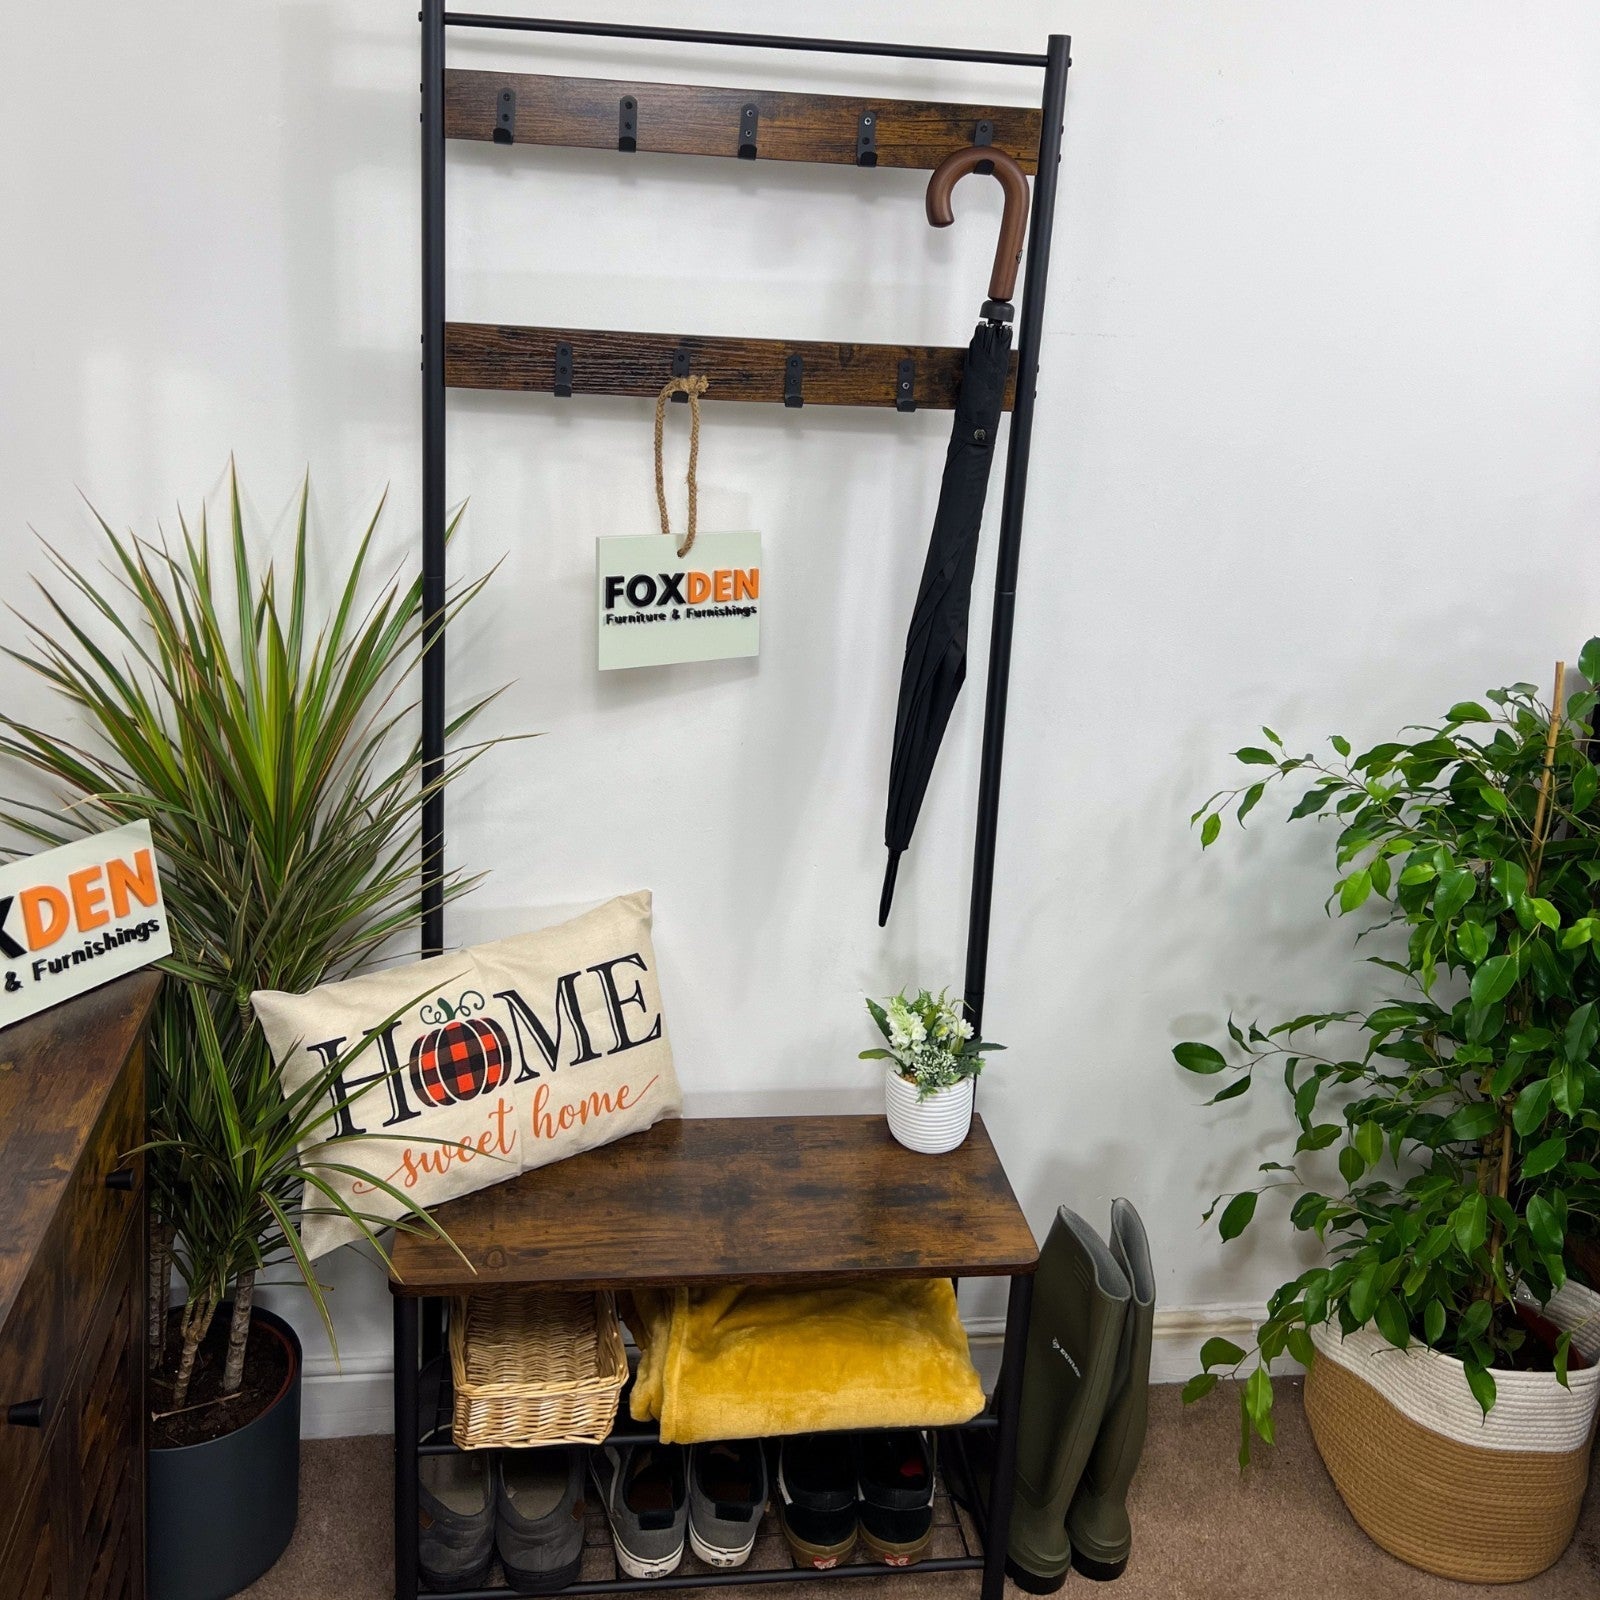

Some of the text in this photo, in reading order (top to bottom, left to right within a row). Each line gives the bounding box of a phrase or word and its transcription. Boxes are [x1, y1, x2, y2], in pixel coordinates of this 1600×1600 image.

[605, 567, 759, 609] FOXDEN
[605, 605, 757, 625] Furniture & Furnishings
[4, 919, 160, 993] & Furnishings
[352, 1075, 660, 1195] sweet home
